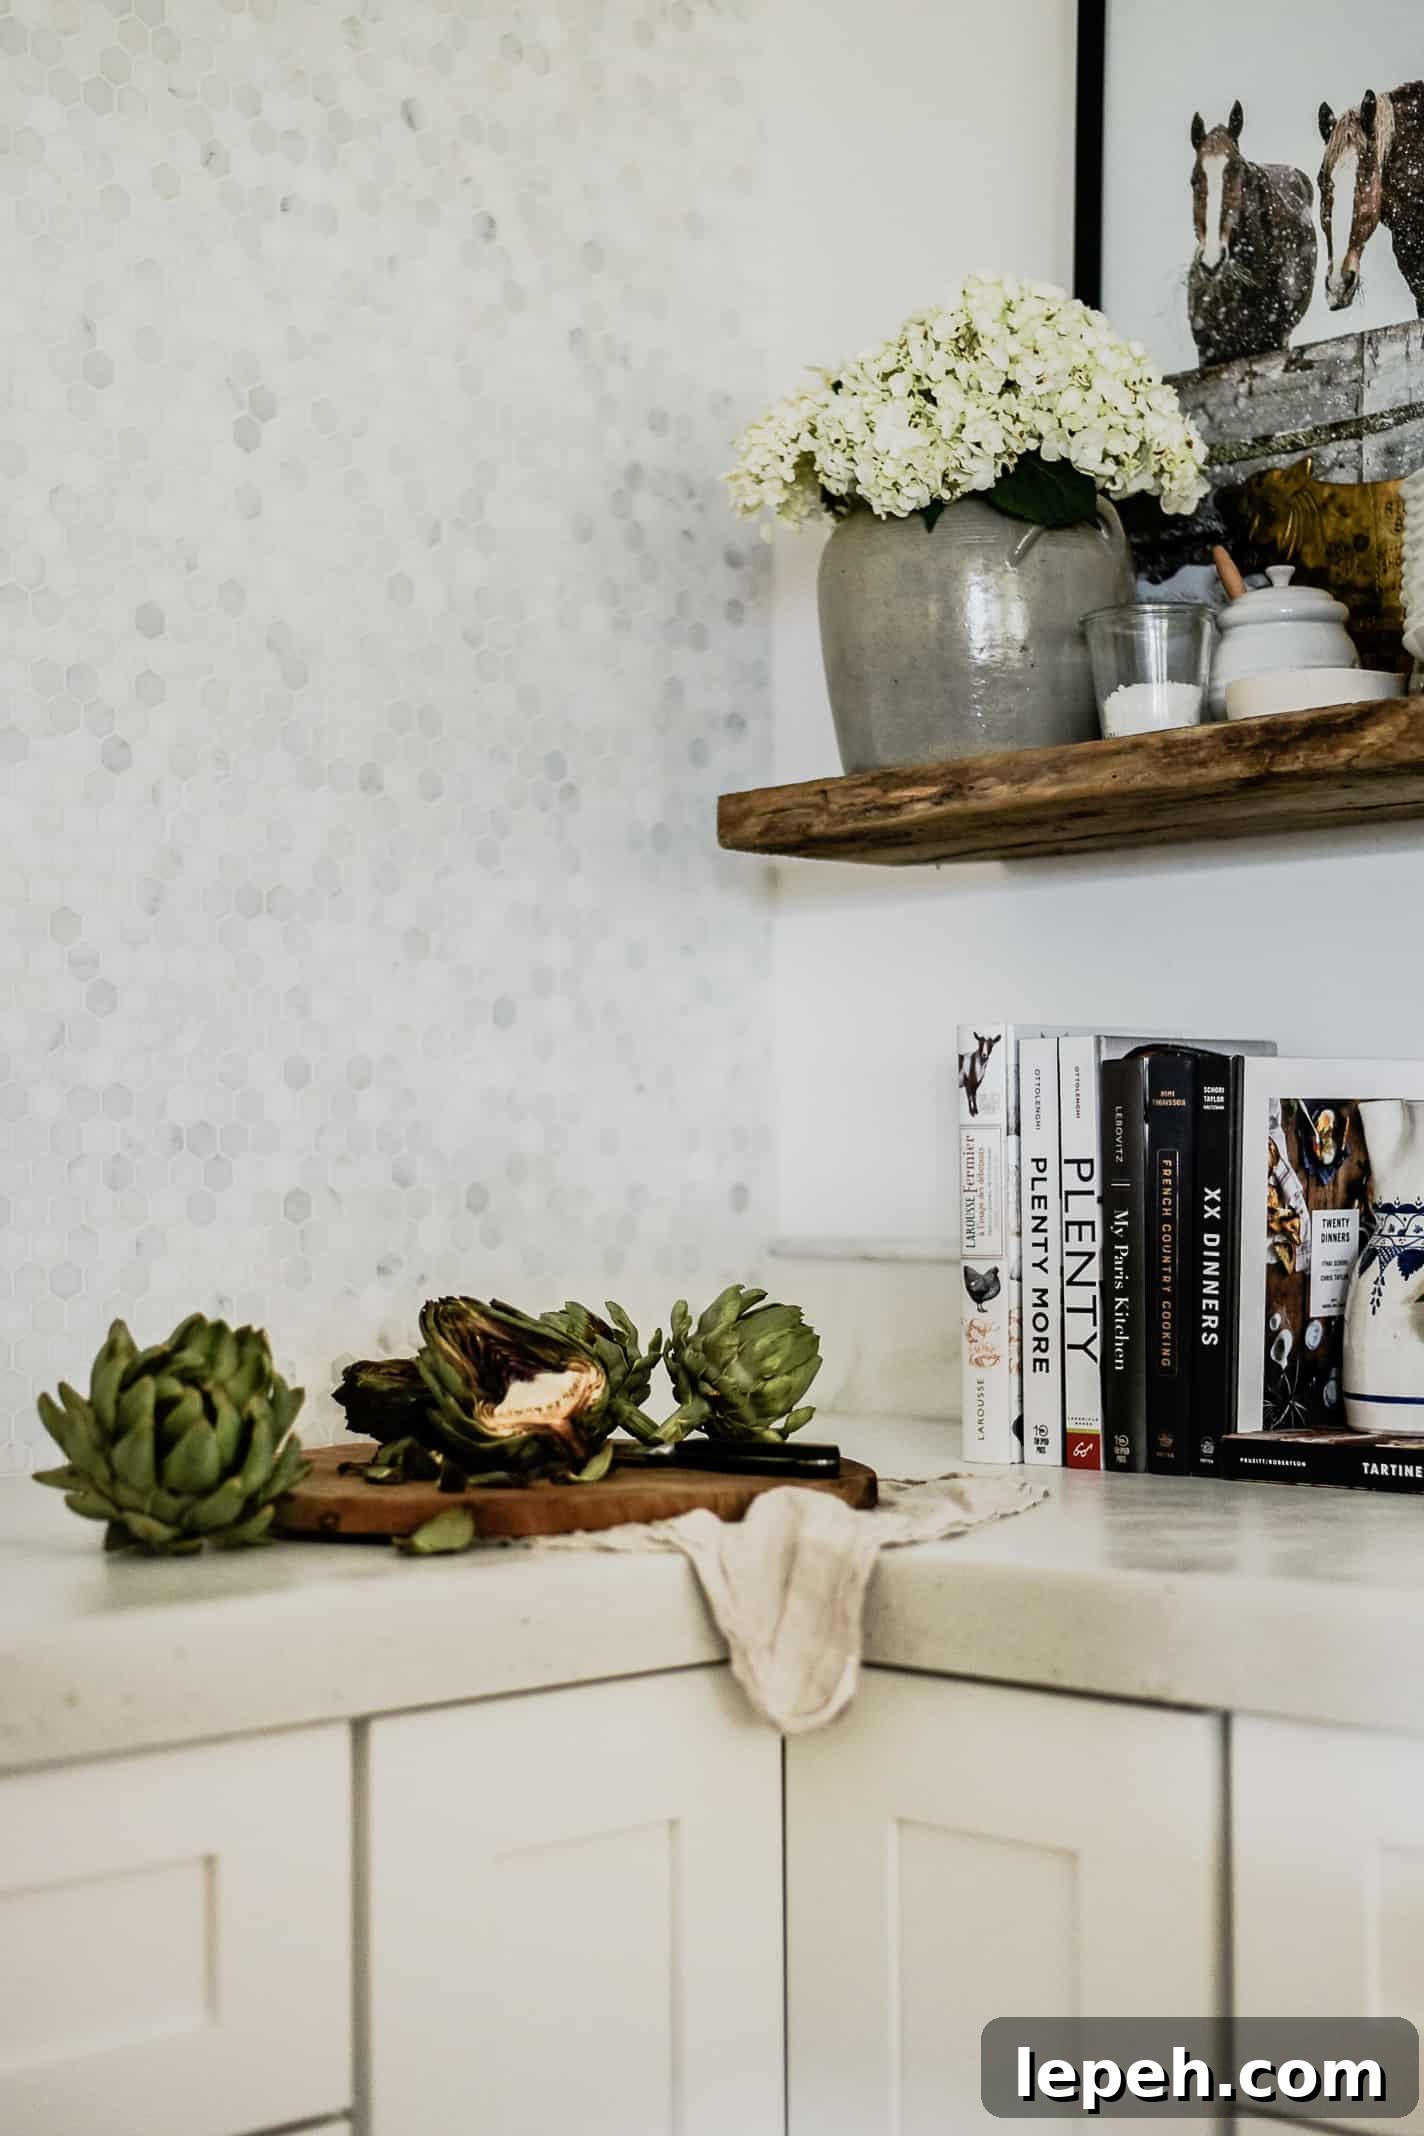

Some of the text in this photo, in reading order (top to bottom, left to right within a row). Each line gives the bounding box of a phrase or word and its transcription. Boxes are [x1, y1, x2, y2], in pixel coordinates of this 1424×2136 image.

[963, 1135, 977, 1249] LAROUSSE Fermier
[1320, 1232, 1350, 1243] DINNERS
[1322, 1217, 1350, 1229] TWENTY
[1031, 1157, 1050, 1374] PLENTY MORE
[1064, 1158, 1098, 1364] PLENTY
[1110, 1210, 1130, 1370] My Paris Kitchen
[1160, 1159, 1173, 1367] FRENCH COUNTRY COOKING
[1201, 1187, 1221, 1346] XX DINNERS
[977, 1378, 985, 1441] LAROUSSE
[1362, 1462, 1424, 1478] TARTINE
